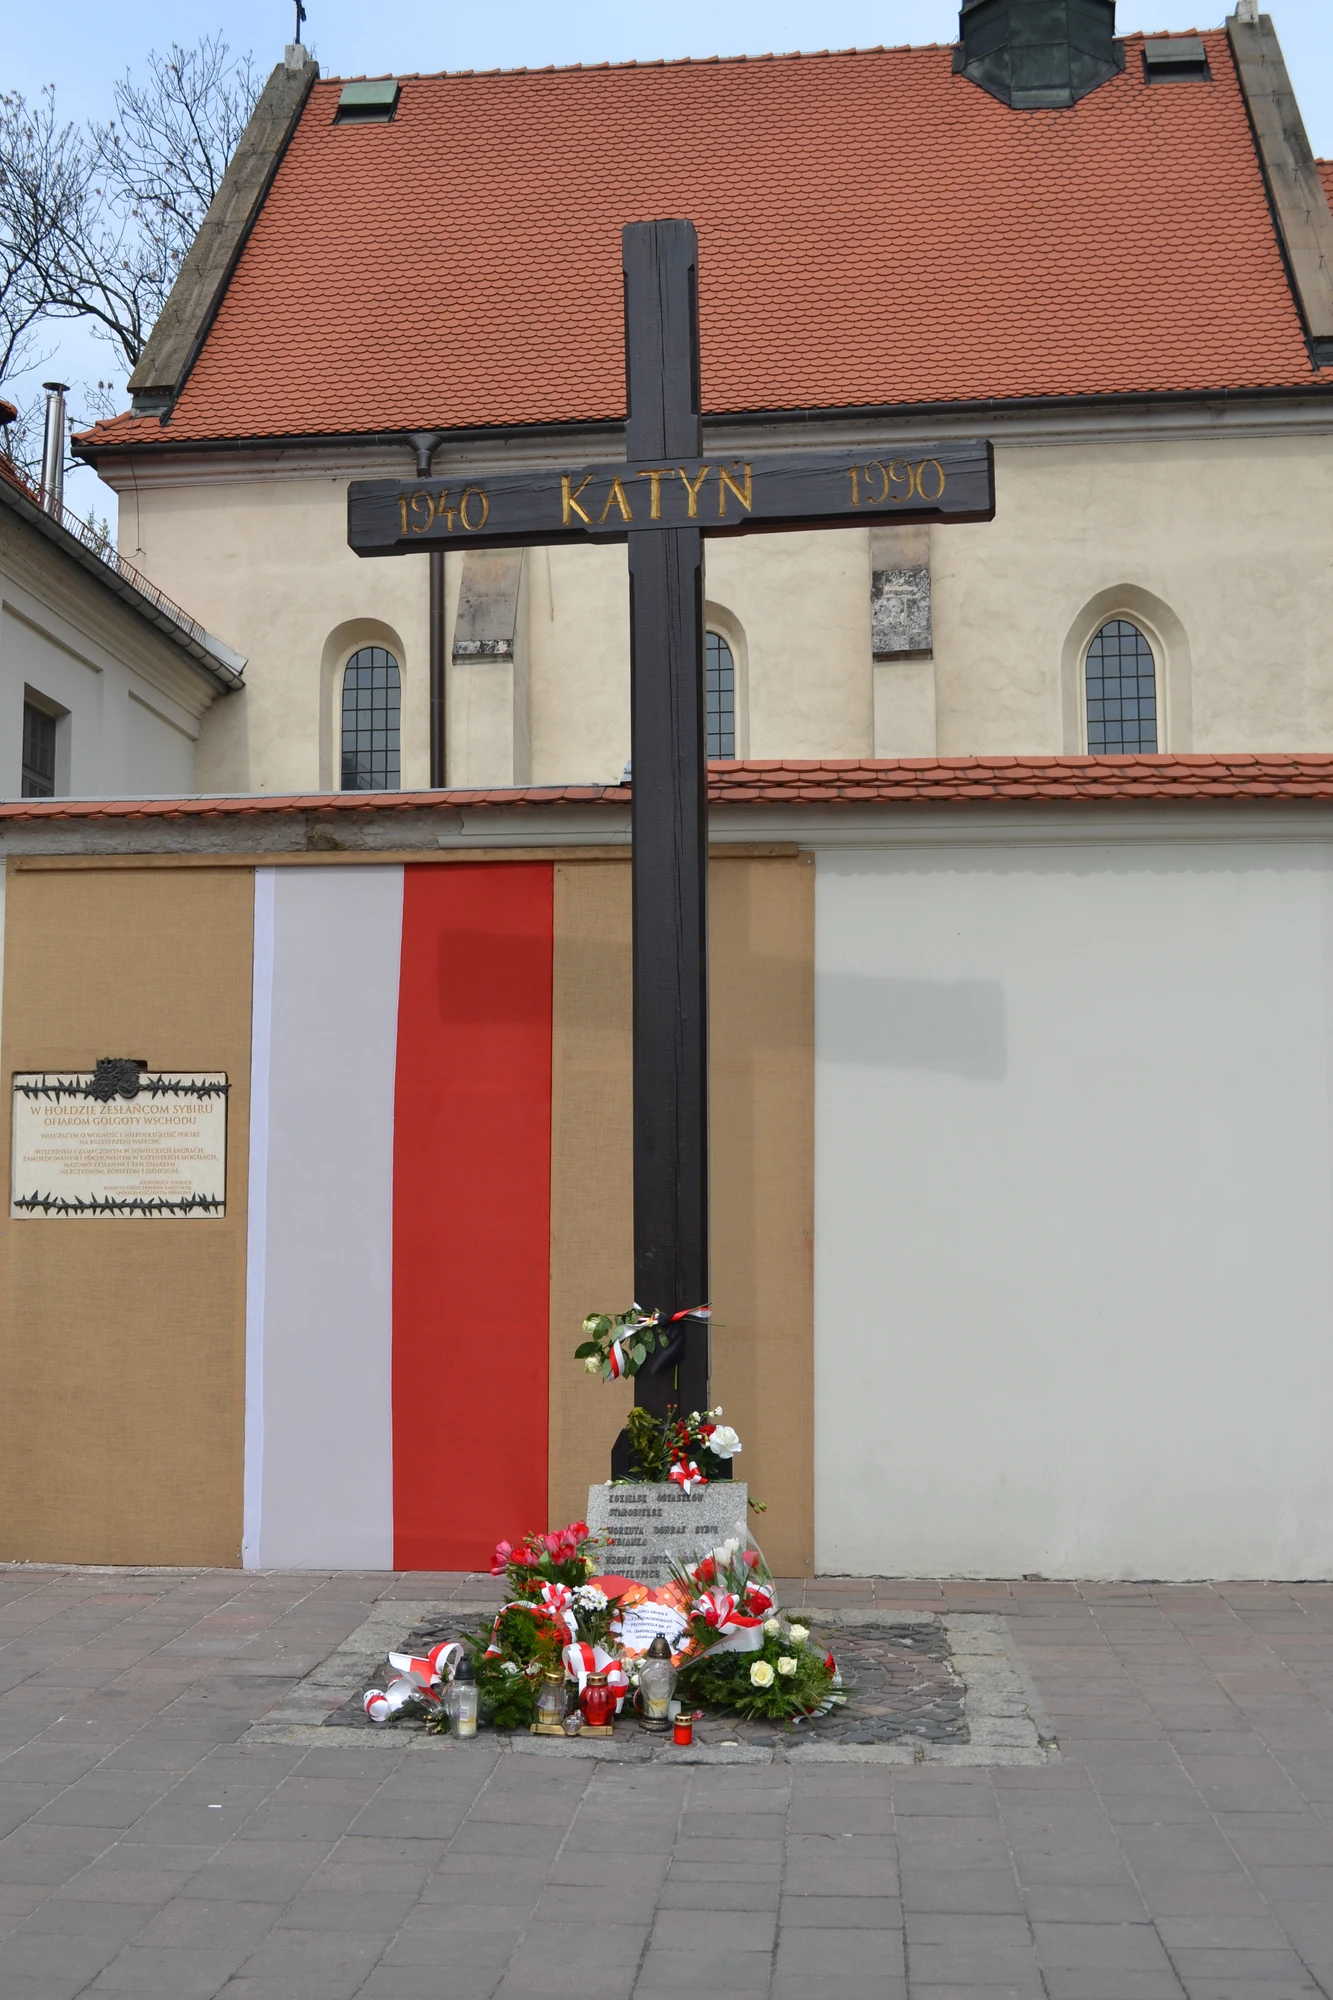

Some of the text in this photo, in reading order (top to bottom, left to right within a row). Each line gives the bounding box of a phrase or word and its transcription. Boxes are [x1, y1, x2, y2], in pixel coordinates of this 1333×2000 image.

[398, 457, 946, 534] 1940 KATYŃ 1990
[30, 1103, 213, 1115] W HOŁDZIE ZESŁAŃCOM SYBIRU
[44, 1116, 196, 1126] OFIAROM GOLGOTY WSCHODU
[609, 1494, 647, 1503] KOZIELSK
[609, 1509, 662, 1517] STAROBIELSK
[608, 1527, 644, 1535] WORKUTA
[695, 1526, 719, 1534] SYBIR
[605, 1556, 635, 1565] WRONKI
